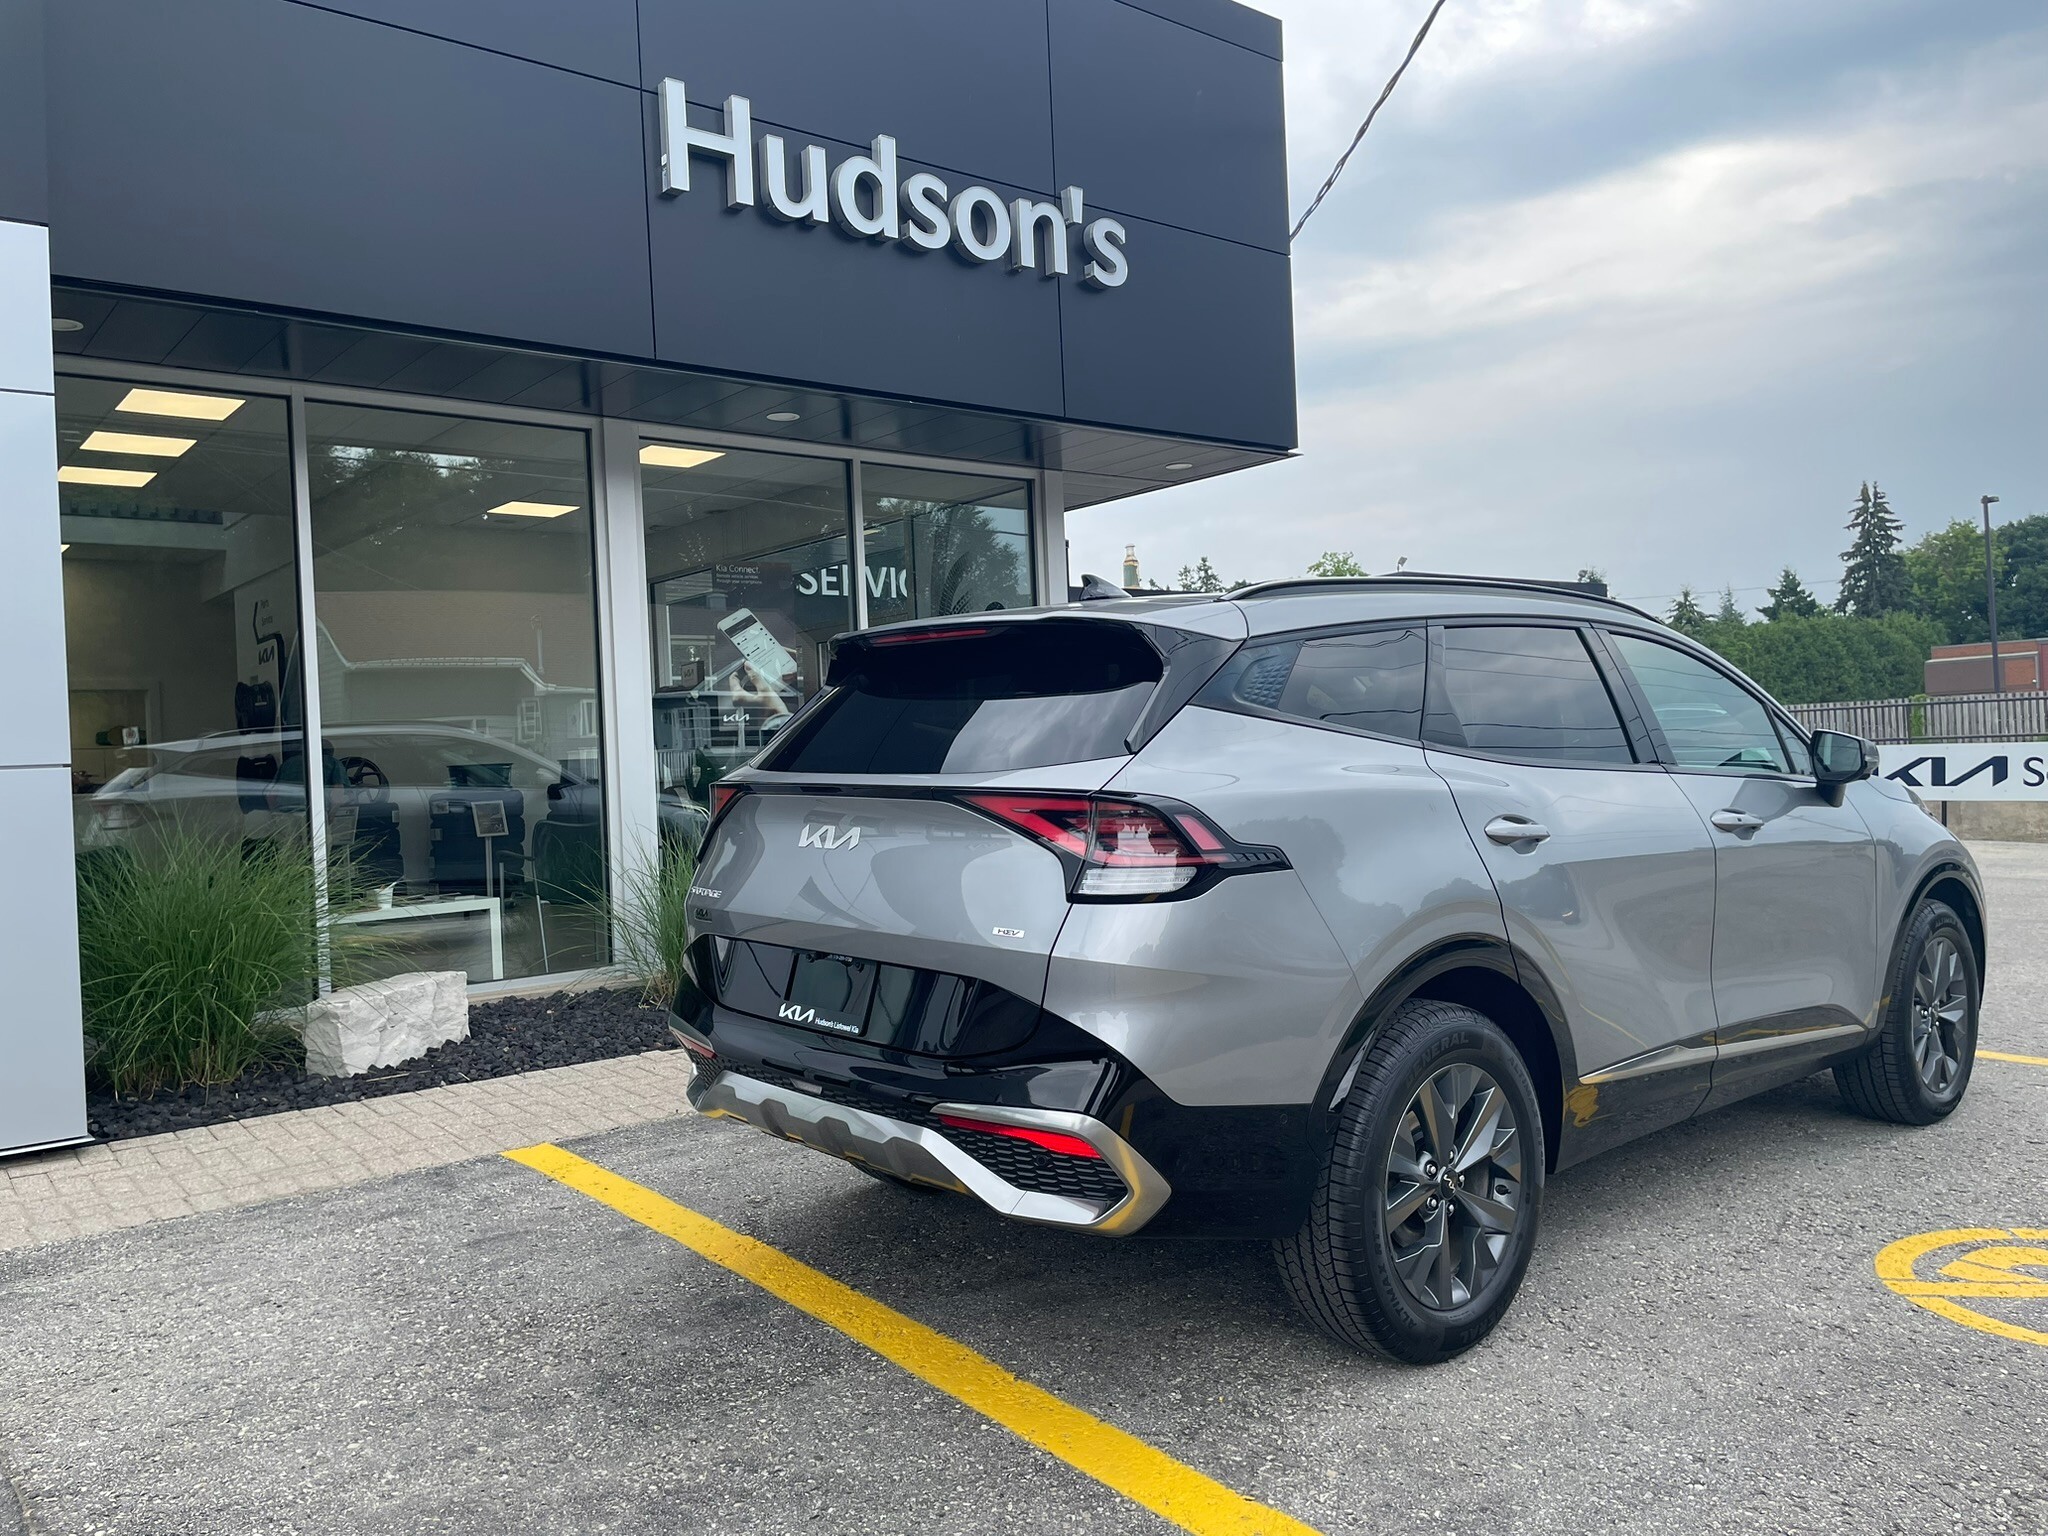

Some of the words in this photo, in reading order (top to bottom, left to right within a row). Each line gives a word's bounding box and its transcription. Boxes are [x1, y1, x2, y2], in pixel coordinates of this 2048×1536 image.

[658, 76, 1129, 290] Hudson's
[723, 713, 750, 722] KIA
[1872, 755, 2009, 788] KIA
[2022, 756, 2048, 788] S
[798, 824, 861, 851] KIA
[997, 928, 1021, 936] HEV
[778, 1002, 816, 1023] KIA
